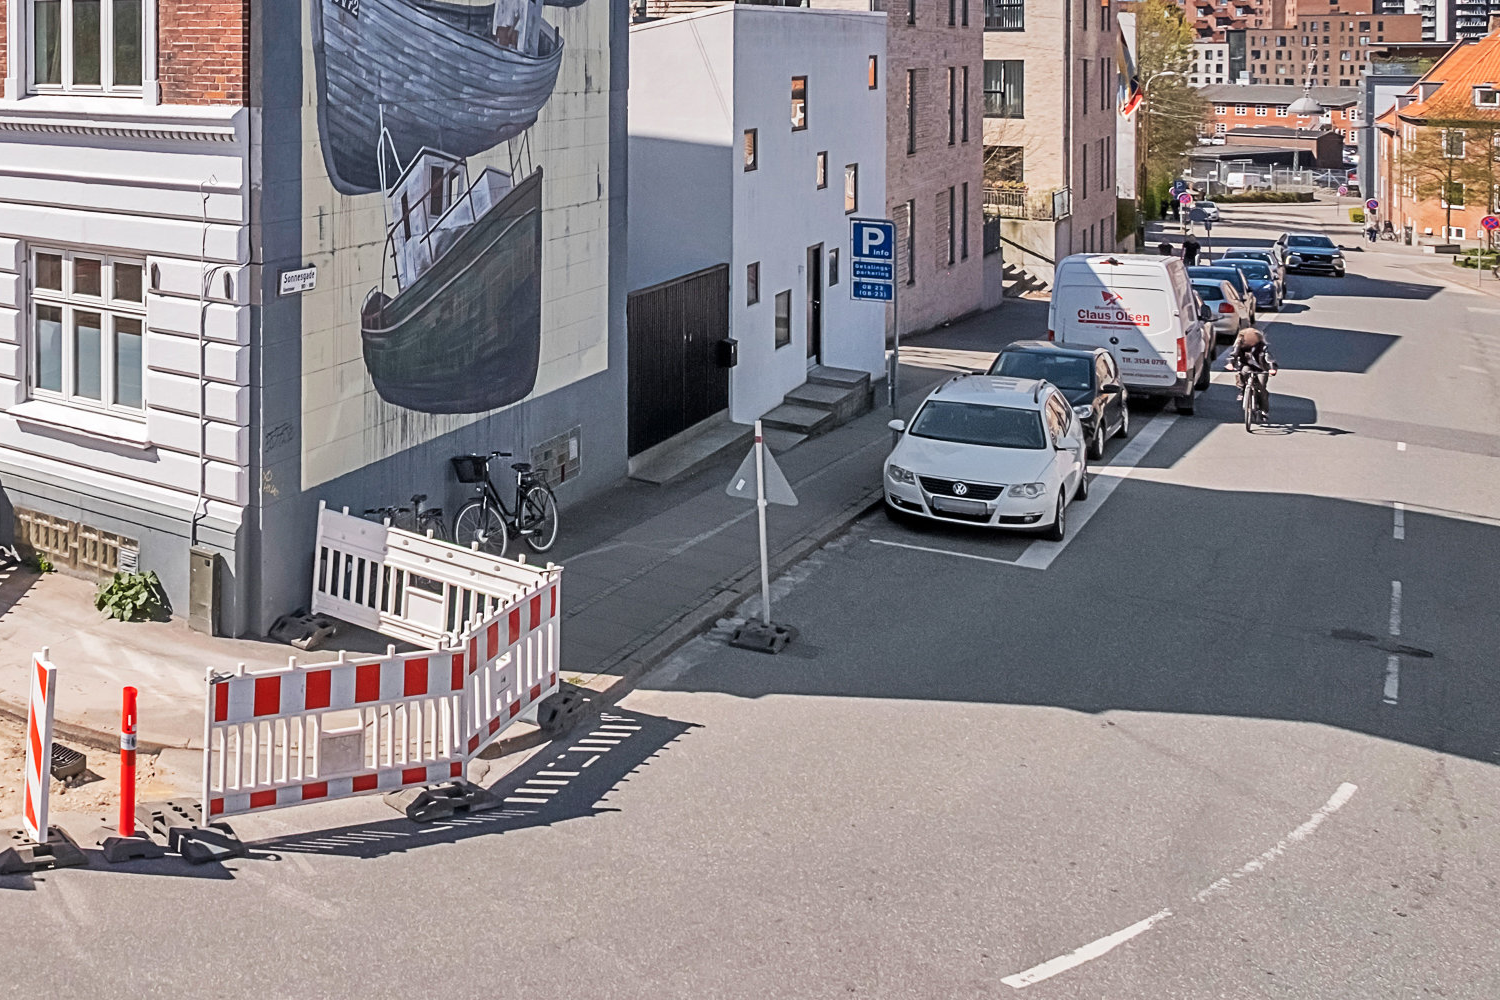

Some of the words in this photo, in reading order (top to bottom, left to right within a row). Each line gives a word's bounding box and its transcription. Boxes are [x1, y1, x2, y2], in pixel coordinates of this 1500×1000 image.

[862, 226, 885, 255] P
[284, 270, 315, 283] Sonnesgade
[1078, 309, 1111, 320] Claus
[1116, 311, 1150, 322] Olsen
